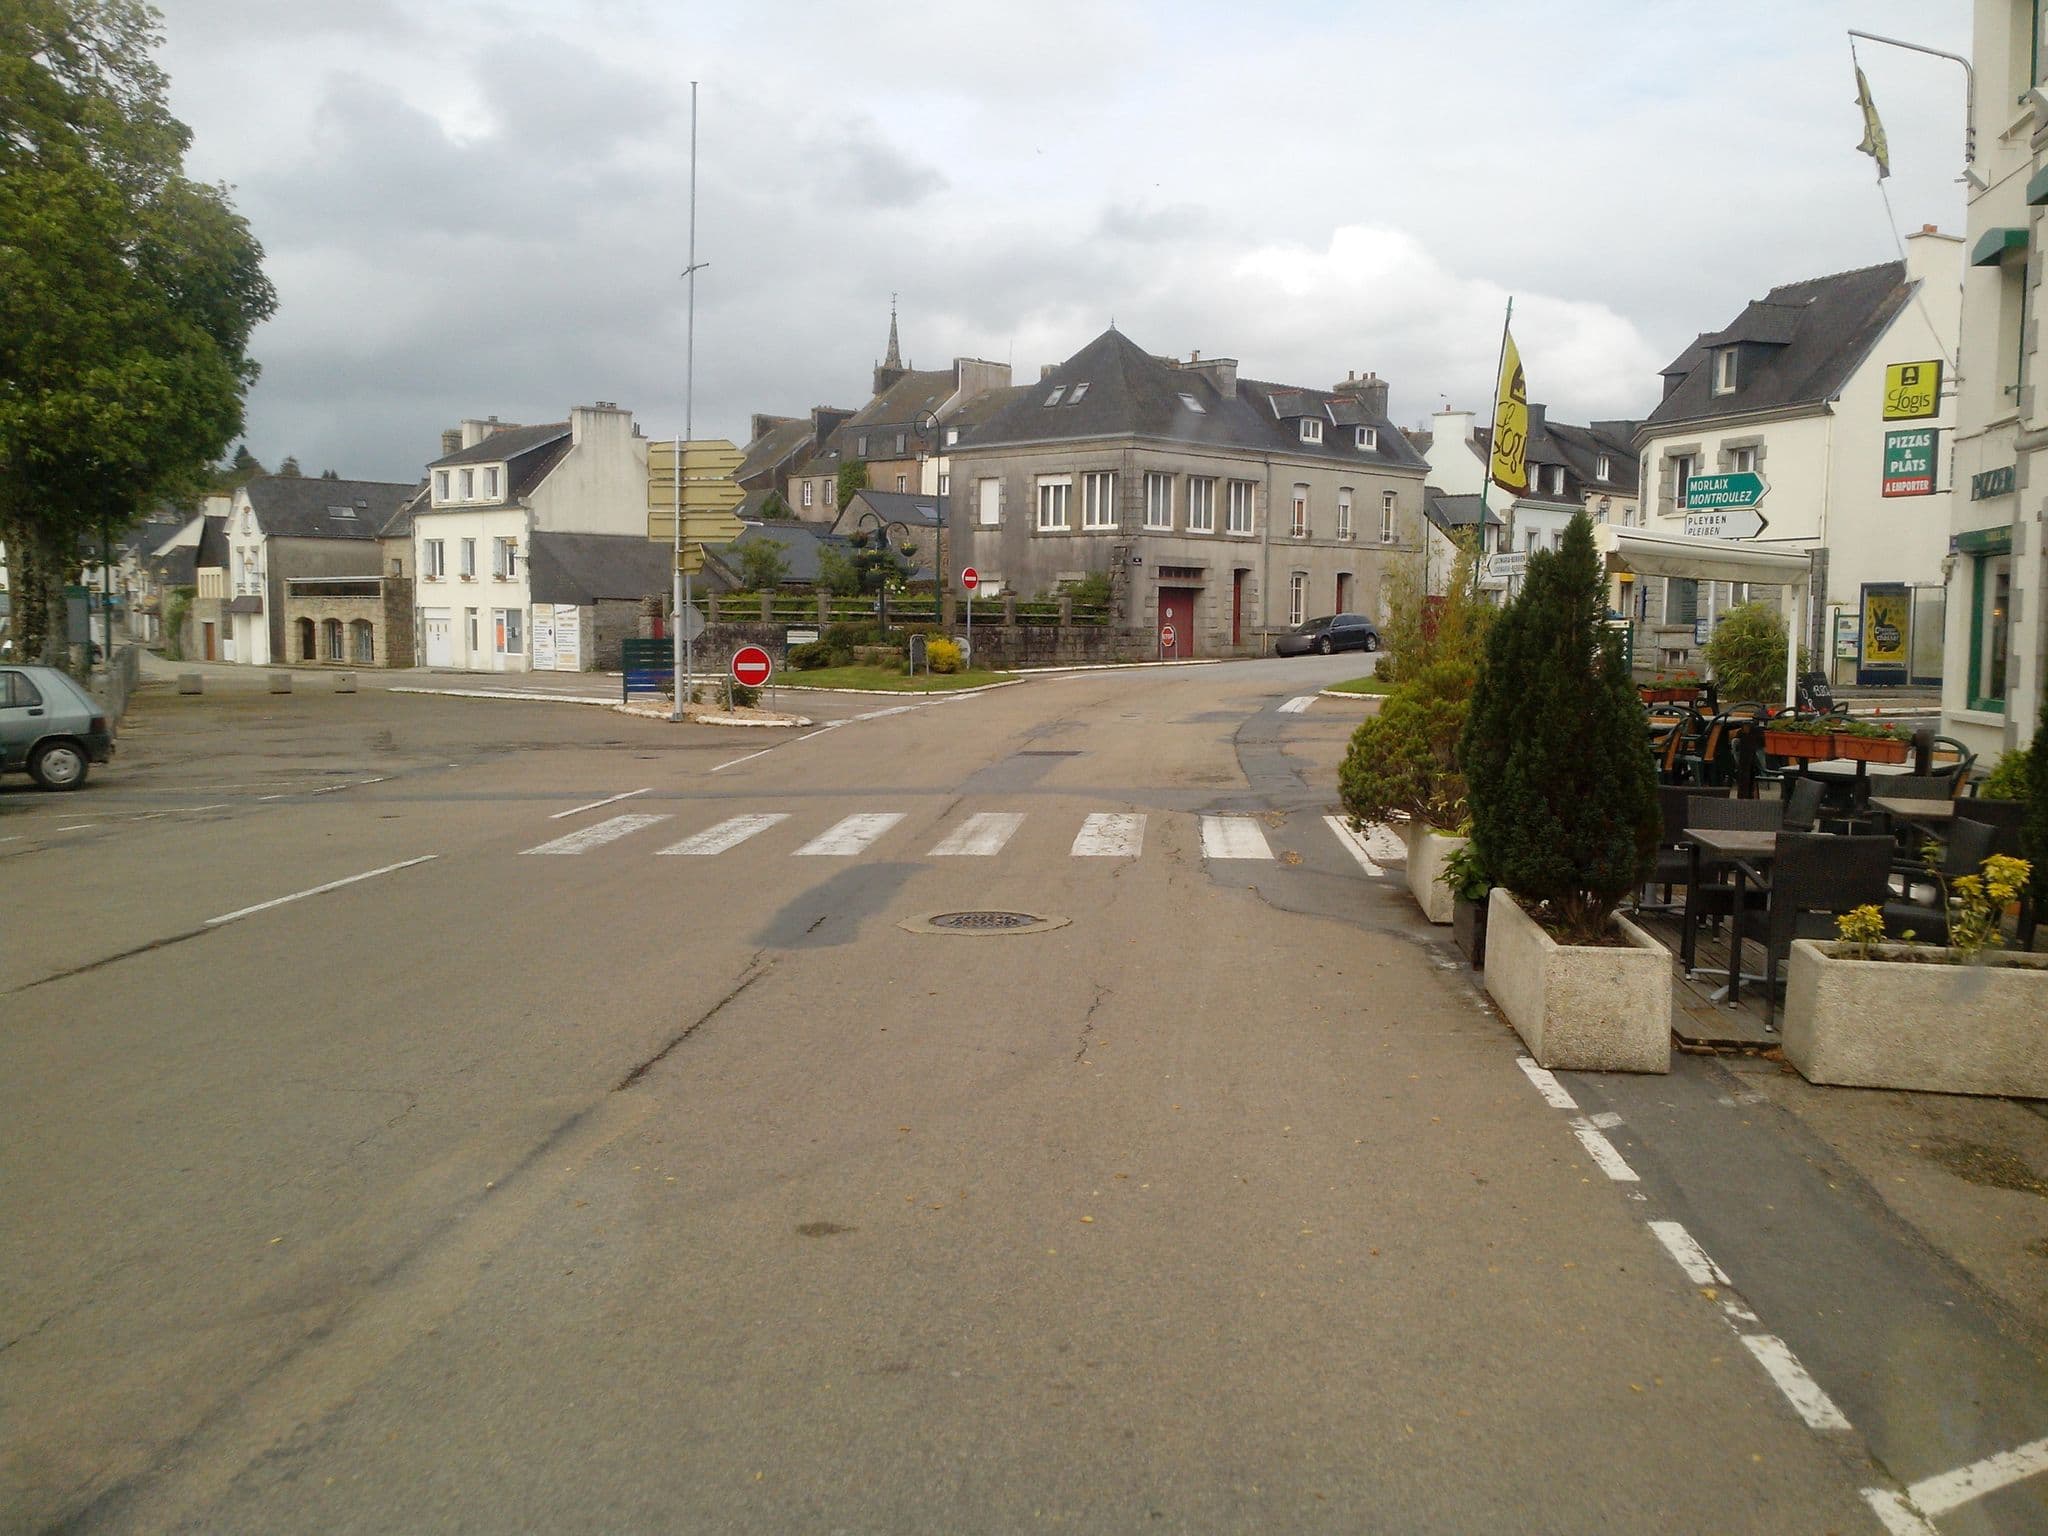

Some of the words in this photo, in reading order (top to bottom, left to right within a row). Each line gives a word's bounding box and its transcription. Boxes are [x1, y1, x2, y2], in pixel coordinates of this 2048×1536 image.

[1886, 387, 1930, 413] Logis
[1888, 434, 1931, 449] PIZZAS
[1904, 449, 1912, 459] &
[1890, 459, 1926, 473] PLATS
[1690, 479, 1728, 491] MORLAIX
[1891, 480, 1929, 492] EMPORTER
[1690, 491, 1752, 504] MONTROULEZ
[1688, 516, 1727, 525] PLEYBEN
[1687, 527, 1720, 536] PLEIBEN
